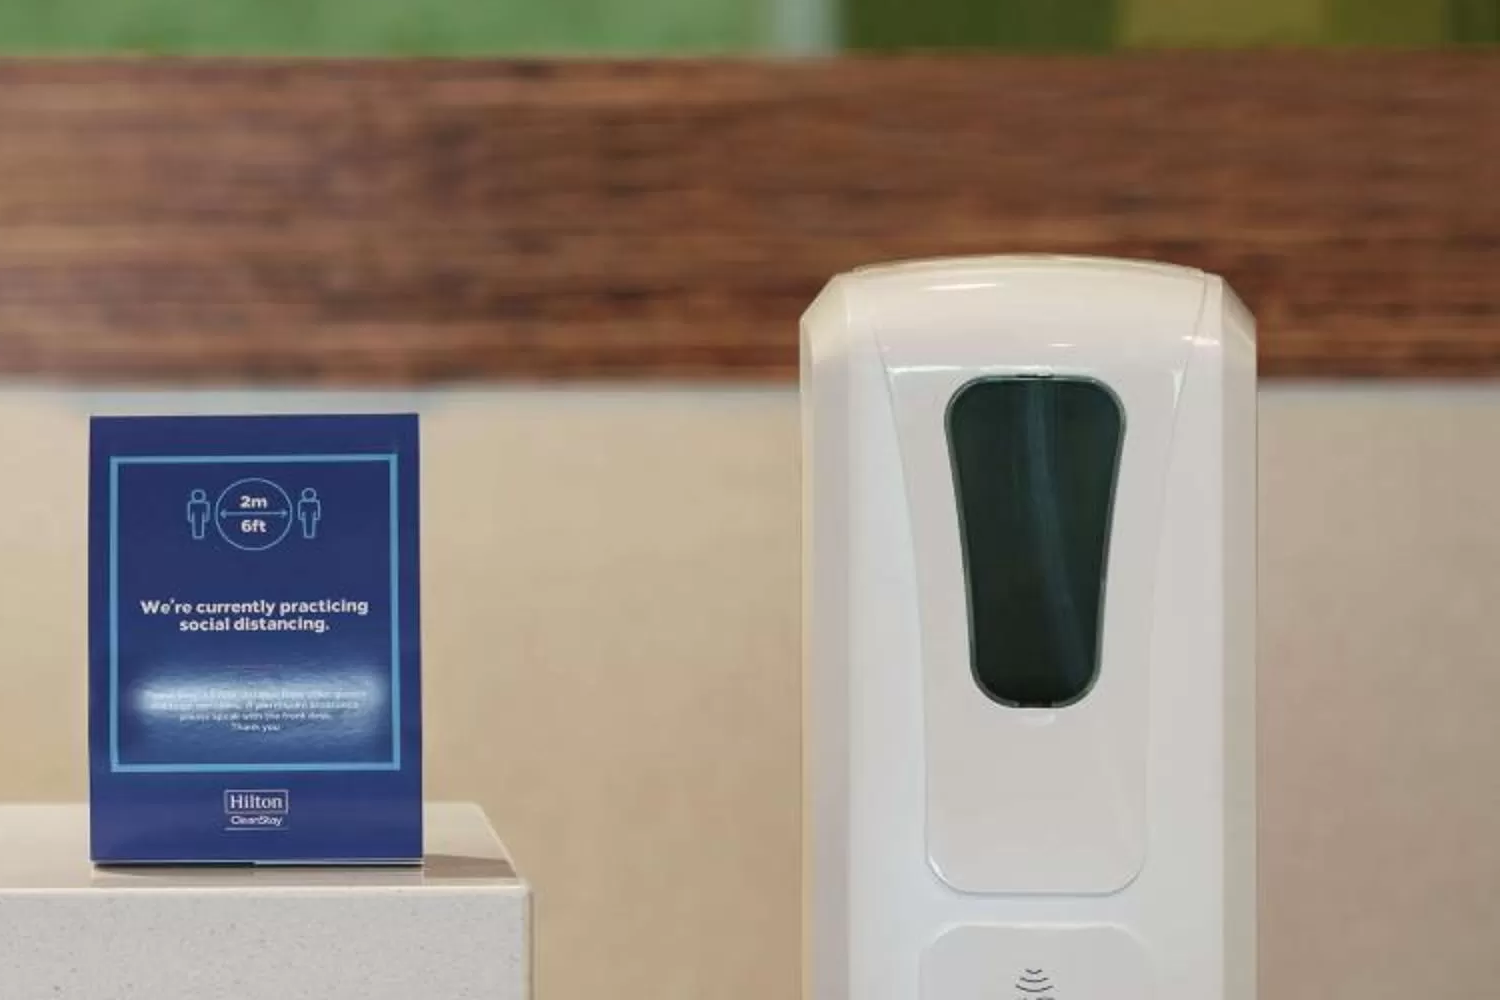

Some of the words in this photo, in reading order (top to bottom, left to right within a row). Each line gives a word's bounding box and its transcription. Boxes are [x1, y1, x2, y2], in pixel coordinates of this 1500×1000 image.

[239, 495, 268, 509] 2m
[240, 519, 267, 533] 6ft
[140, 599, 192, 615] We're
[196, 599, 276, 616] currently
[279, 599, 369, 616] practicing
[179, 617, 230, 631] social
[233, 617, 331, 633] distancing.
[230, 794, 283, 809] Hilton
